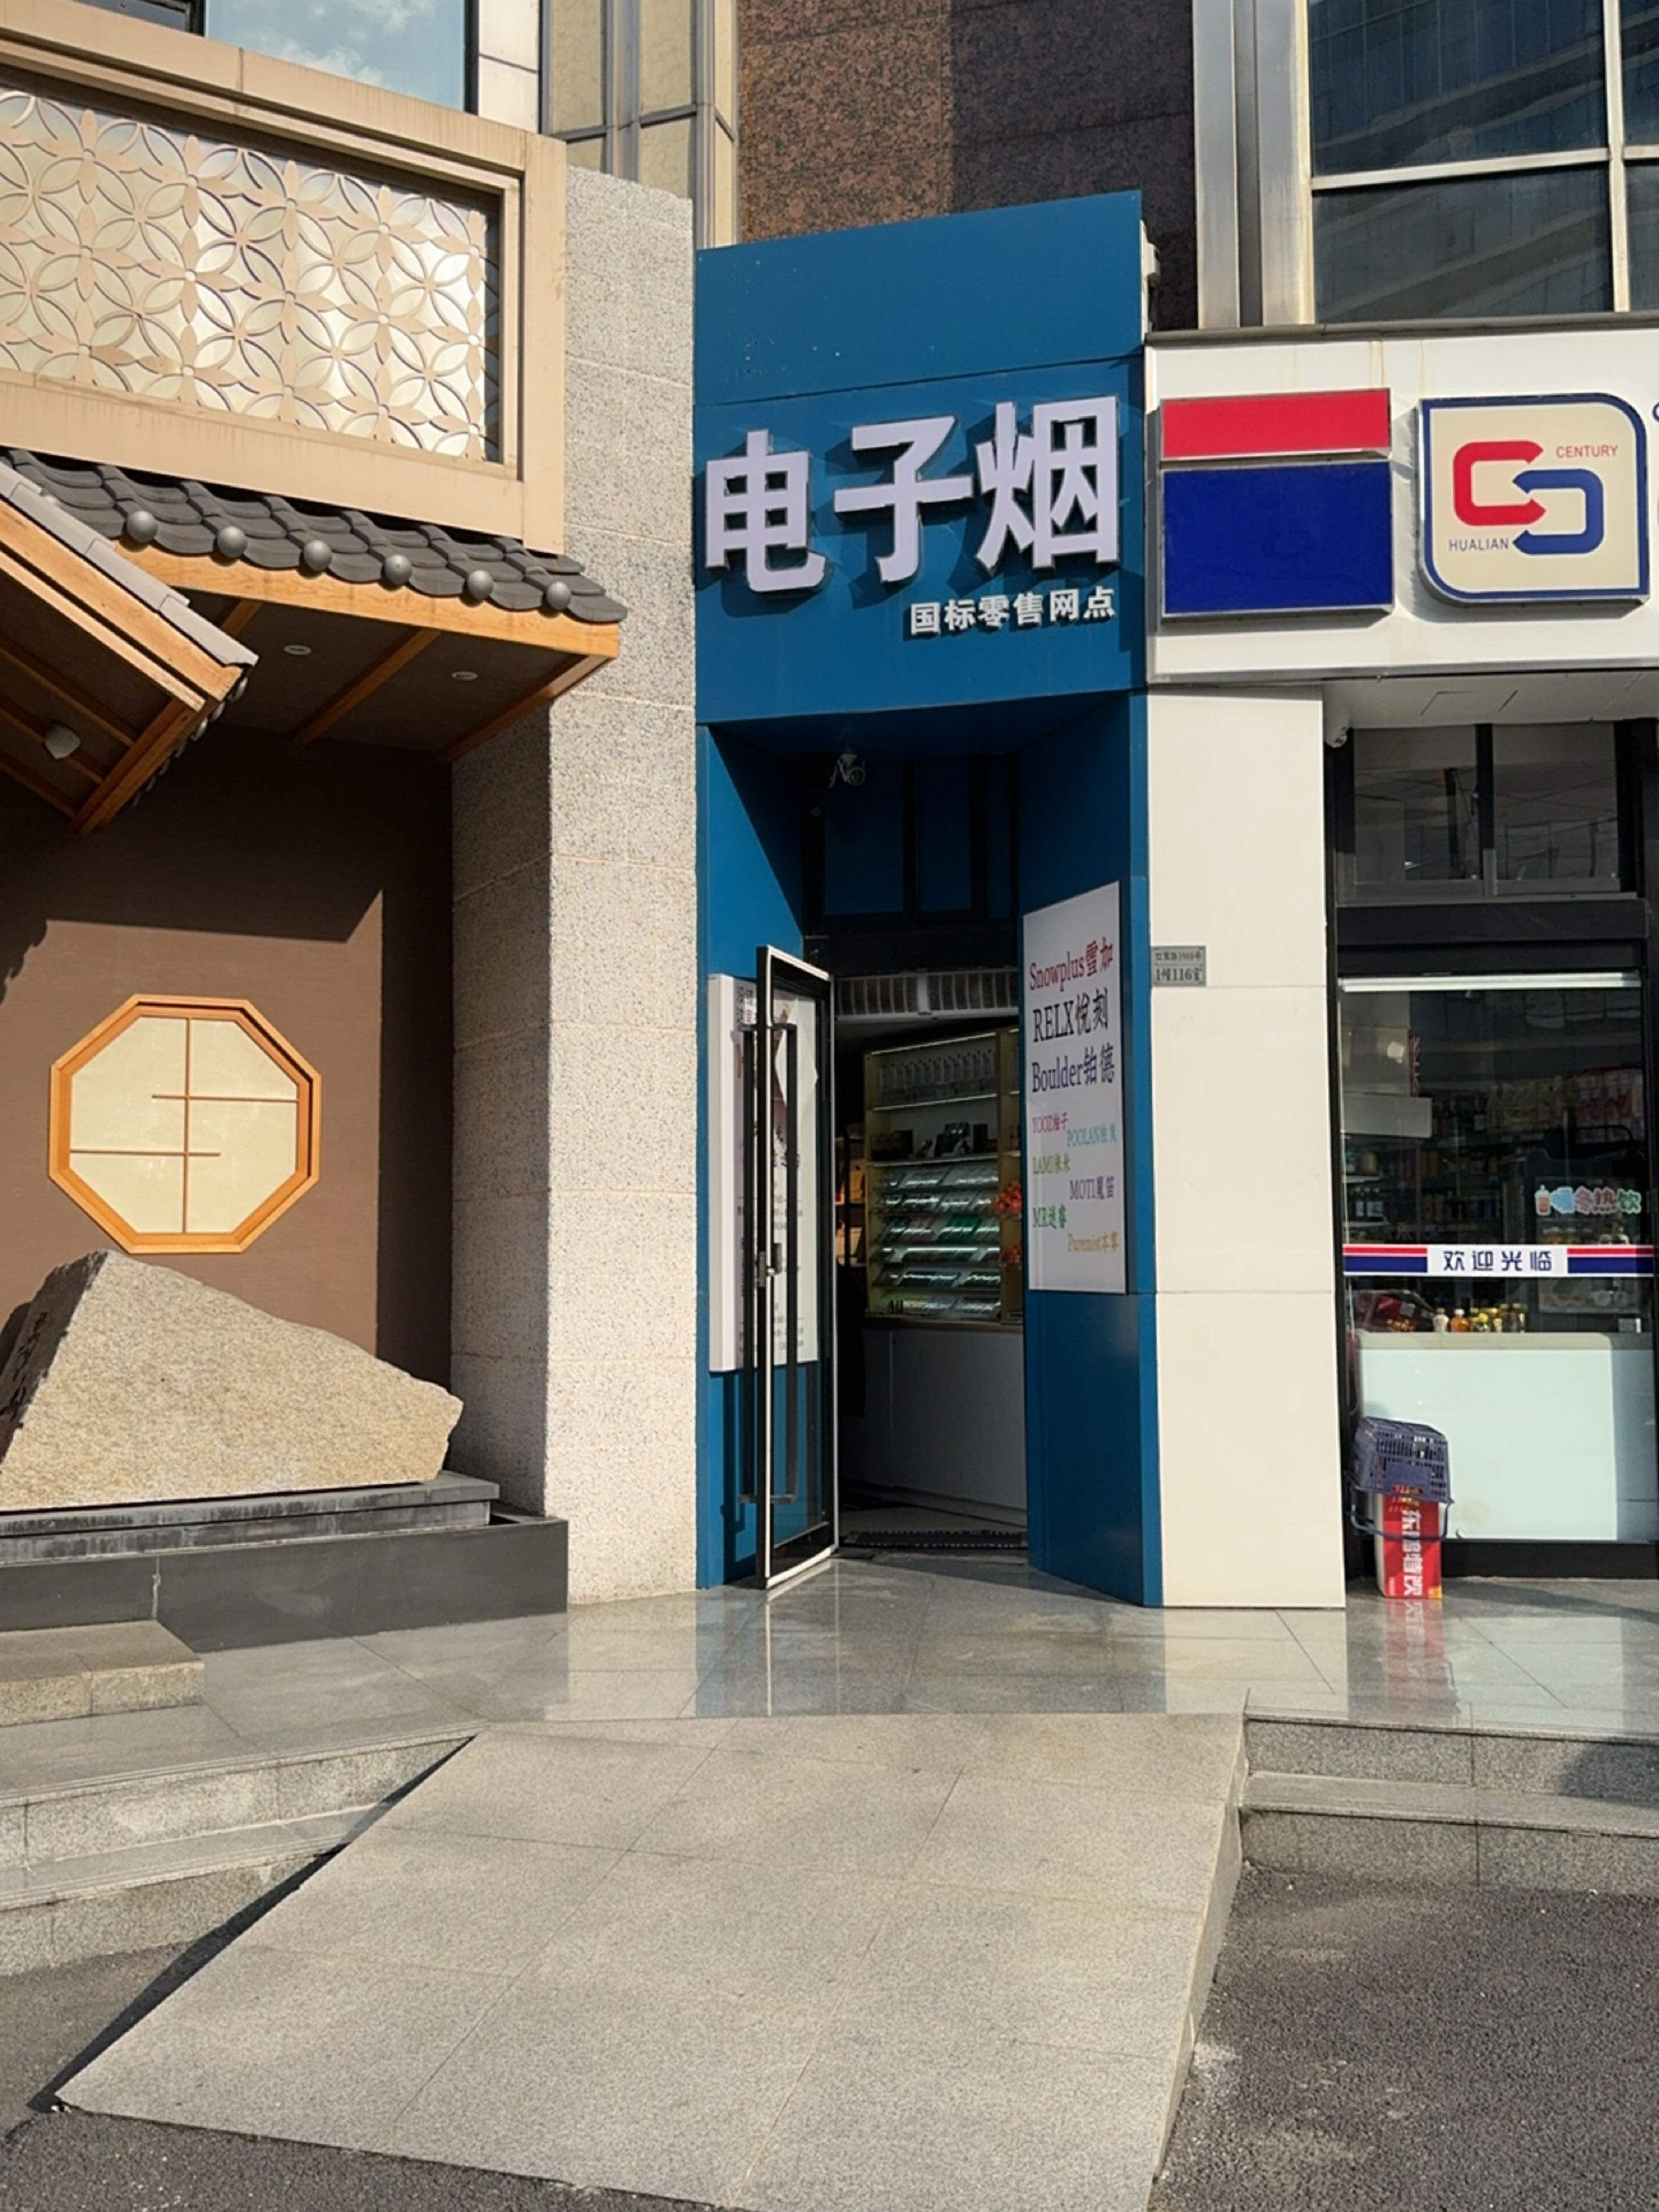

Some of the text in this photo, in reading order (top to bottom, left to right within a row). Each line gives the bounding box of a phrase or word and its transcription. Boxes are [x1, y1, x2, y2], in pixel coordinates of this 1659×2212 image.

[1555, 445, 1619, 458] CENTURY
[705, 395, 1119, 593] 电子烟
[1448, 538, 1509, 552] HUALIAN
[910, 586, 1117, 636] 国标零售网点
[1032, 986, 1109, 1043] RELX悦刻
[1443, 1250, 1552, 1272] 欢迎光临
